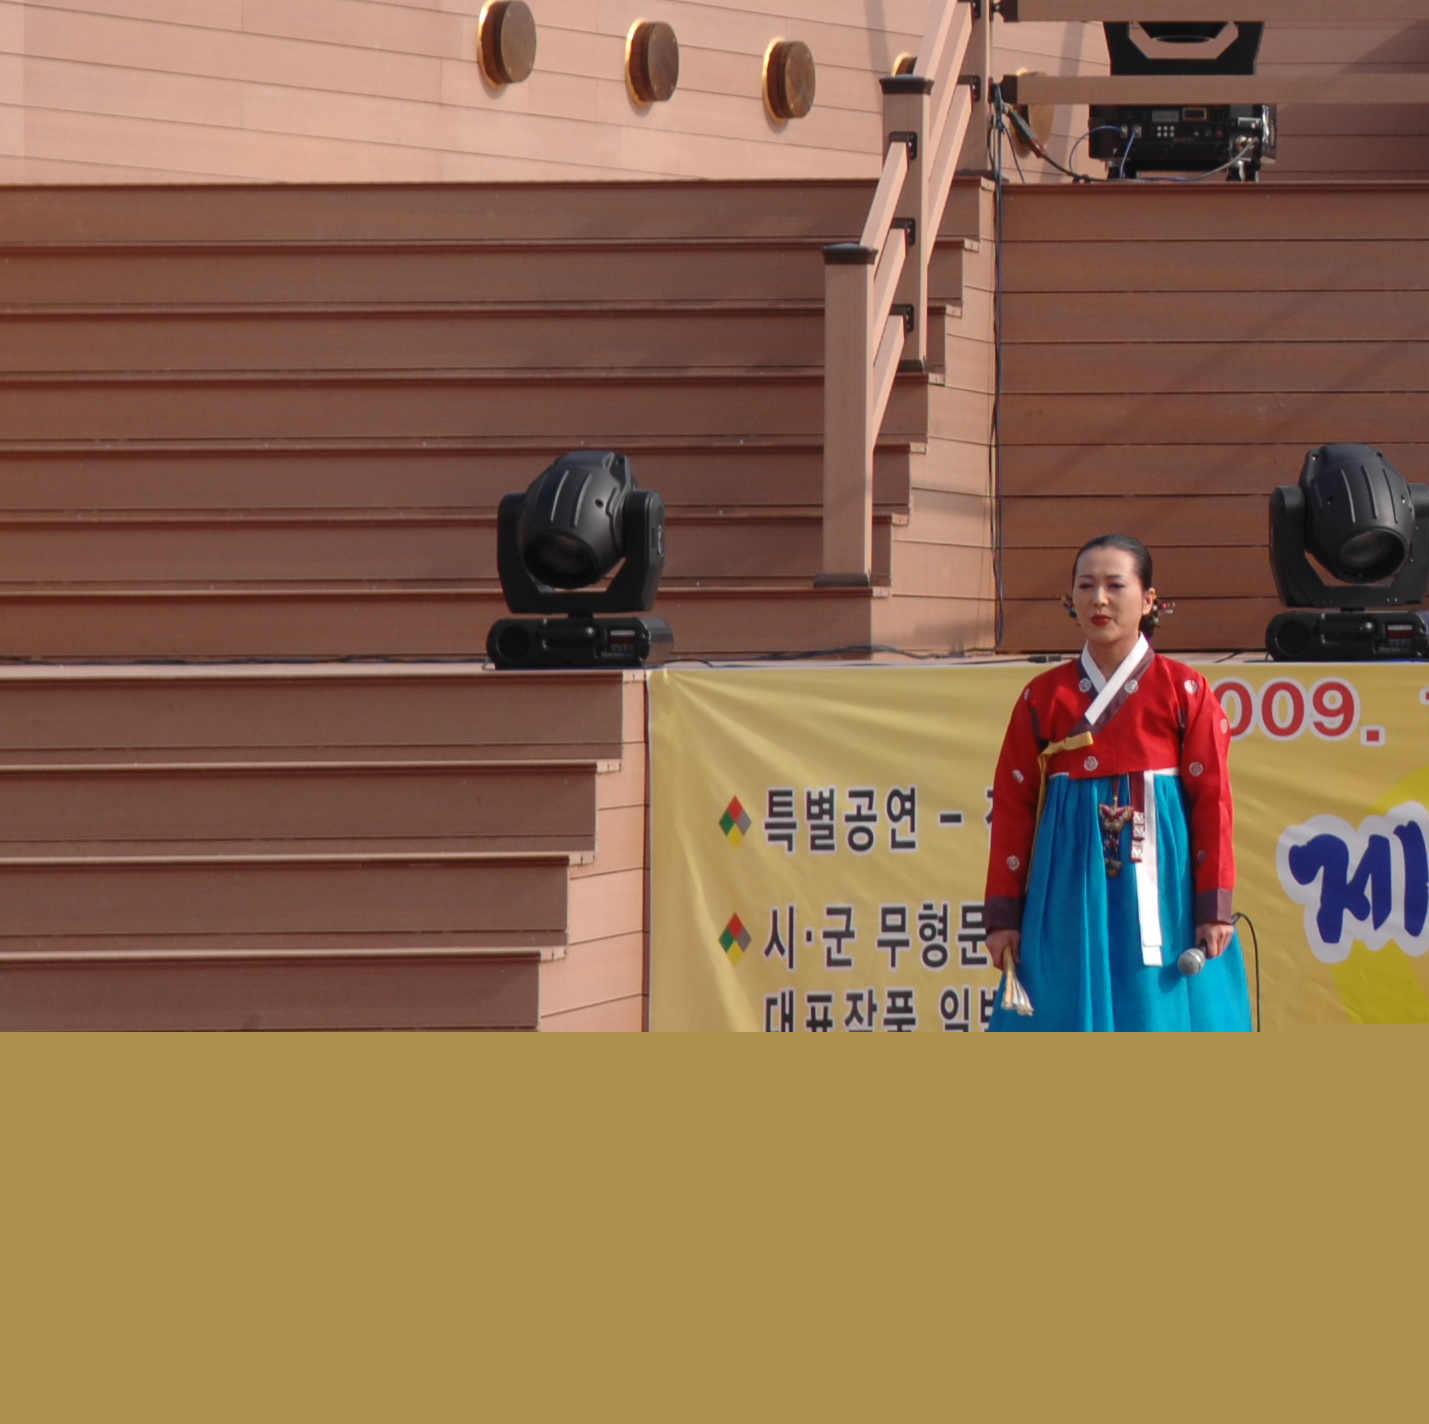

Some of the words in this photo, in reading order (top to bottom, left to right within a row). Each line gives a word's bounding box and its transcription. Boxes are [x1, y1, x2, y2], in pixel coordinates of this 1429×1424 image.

[764, 786, 917, 852] 특별공연
[939, 813, 962, 824] -
[764, 905, 855, 969] 시·군
